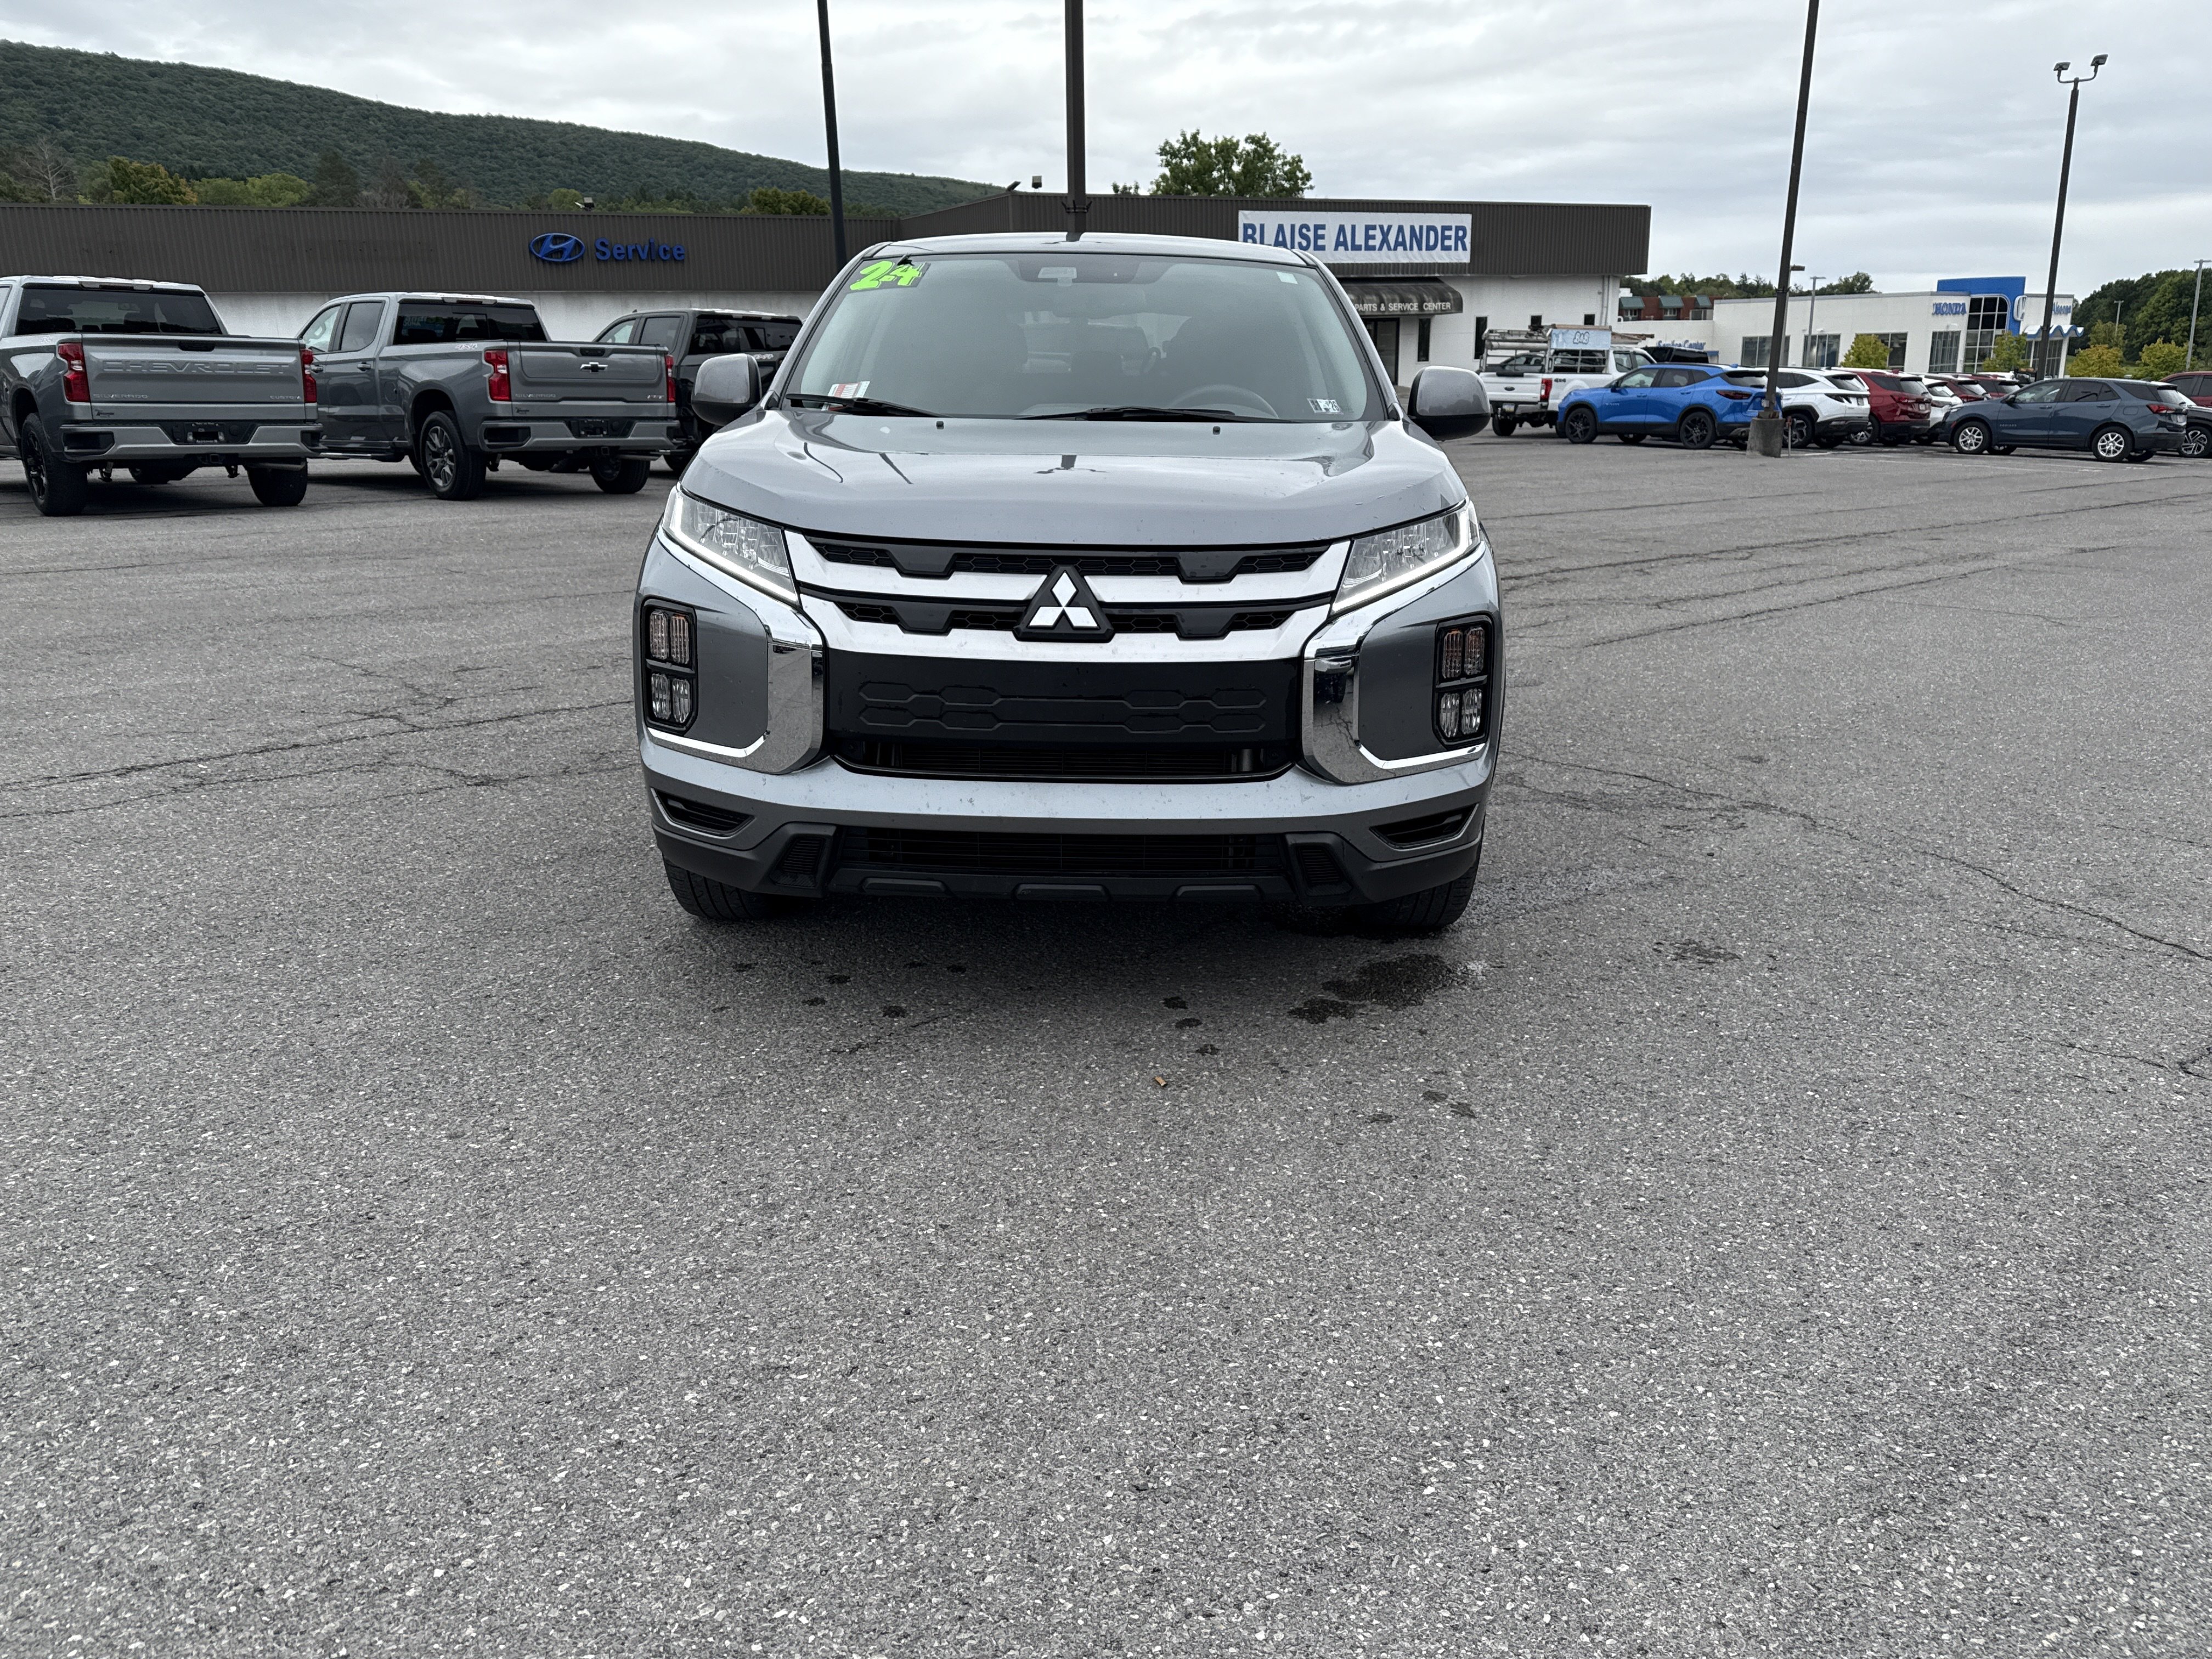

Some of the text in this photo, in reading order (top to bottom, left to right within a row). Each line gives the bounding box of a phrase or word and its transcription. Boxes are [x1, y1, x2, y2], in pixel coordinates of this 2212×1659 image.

[1243, 223, 1468, 251] BLAISE ALEXANDER
[595, 237, 685, 261] Service
[1355, 302, 1451, 312] PARTS & SERVICE CENTER
[1932, 302, 1967, 315] HONDA
[103, 360, 290, 374] CHEVROLET
